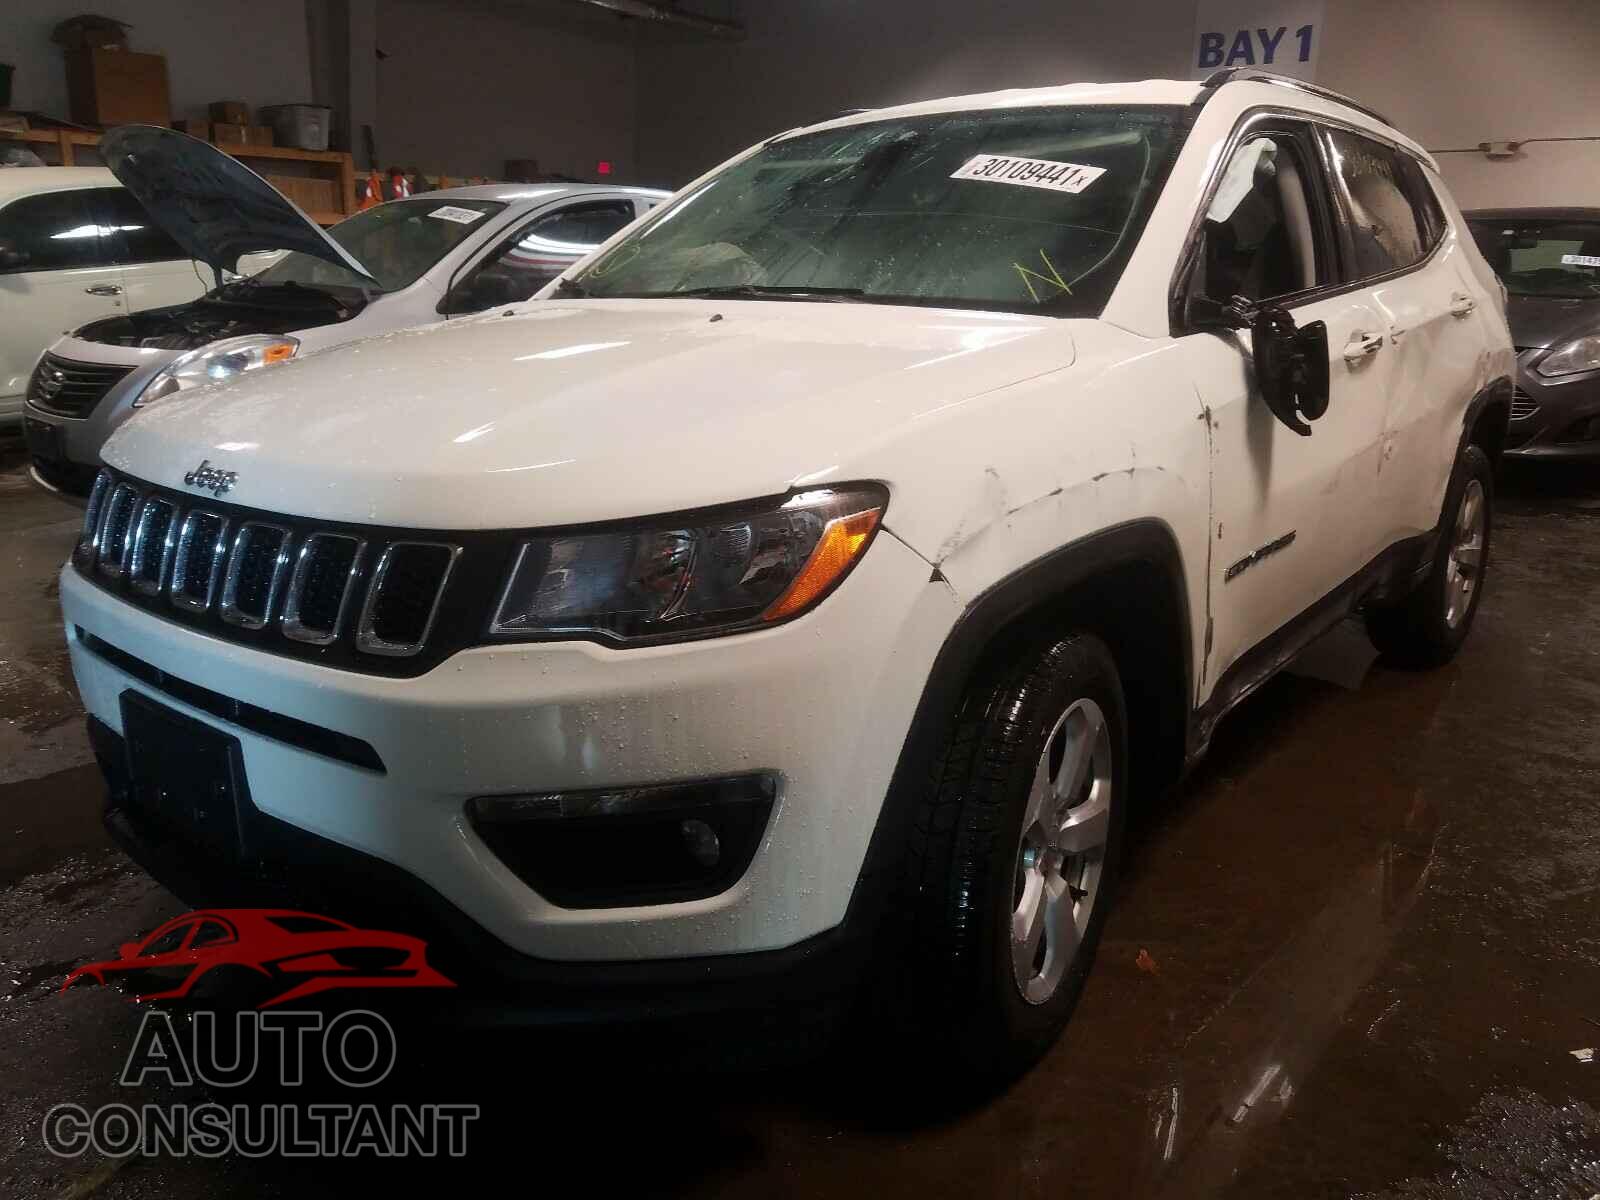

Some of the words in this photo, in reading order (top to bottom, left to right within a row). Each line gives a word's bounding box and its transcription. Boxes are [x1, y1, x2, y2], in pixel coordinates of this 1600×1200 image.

[1199, 27, 1287, 68] BAY
[1295, 25, 1313, 62] 1
[184, 459, 240, 497] Jeep
